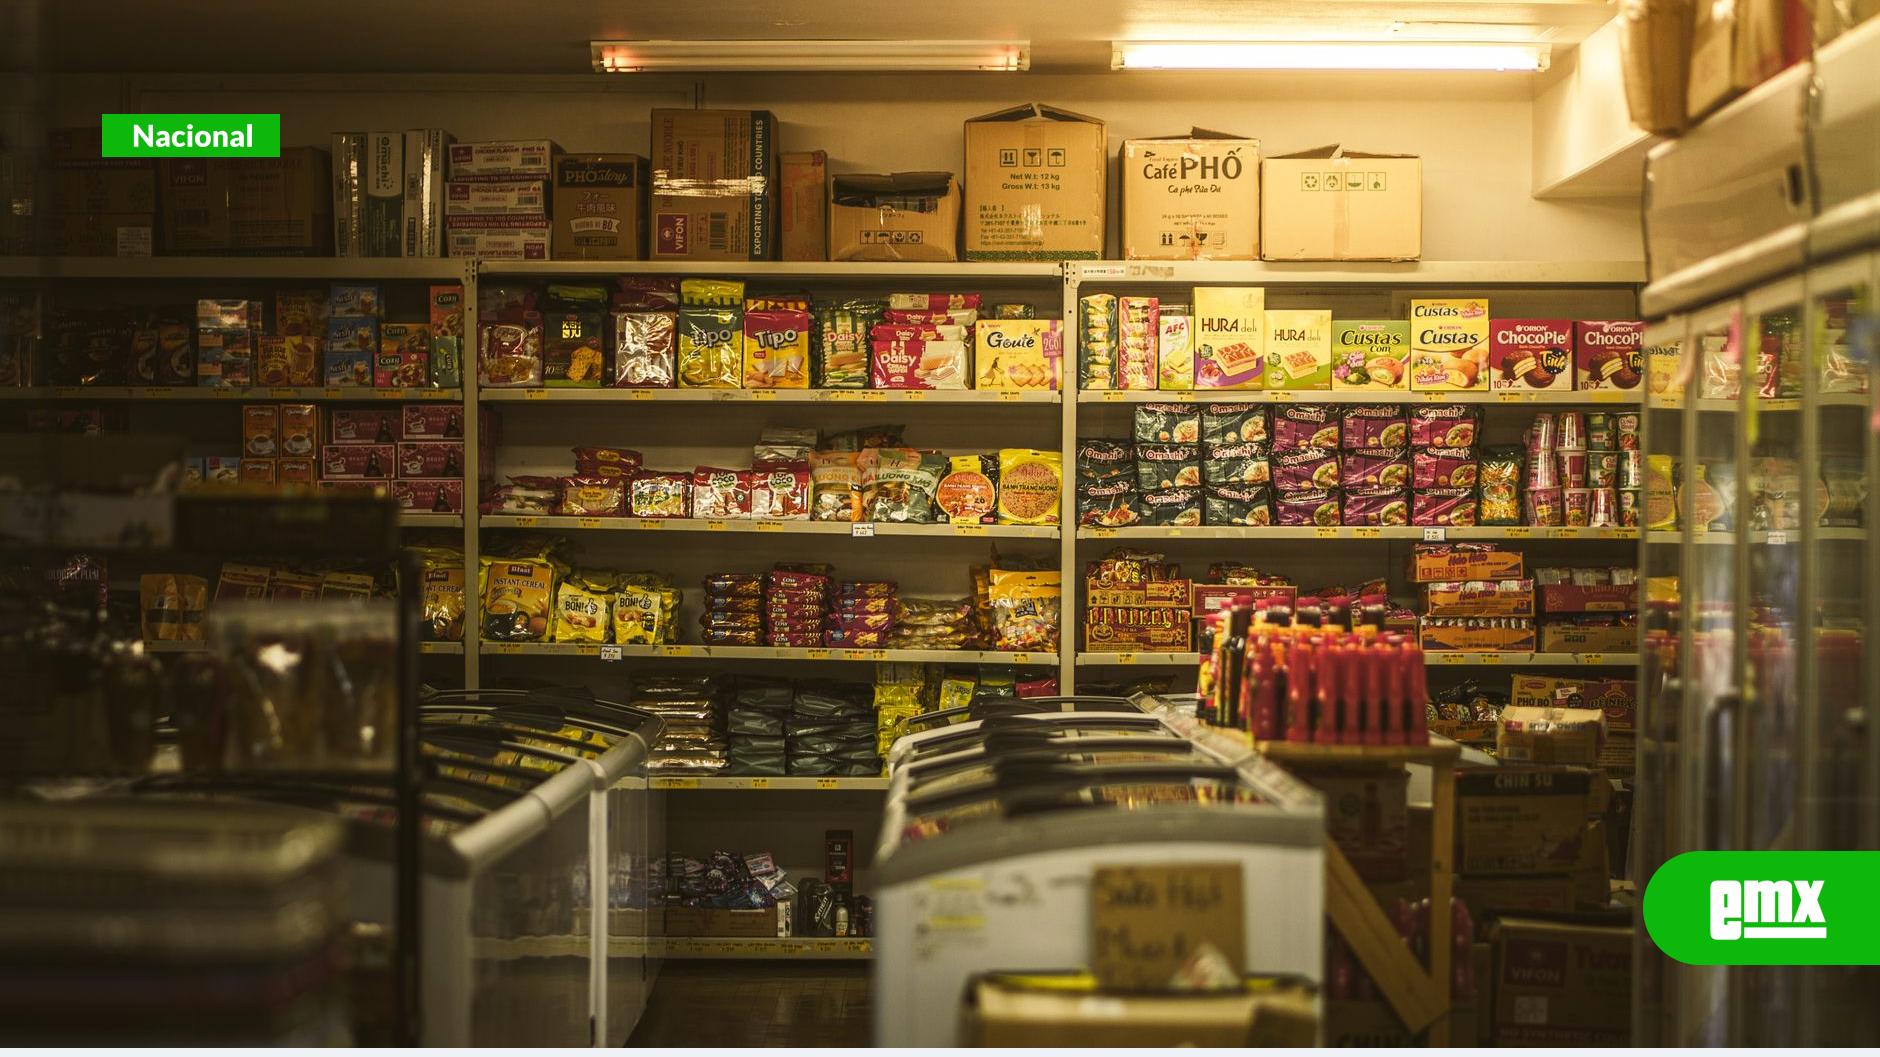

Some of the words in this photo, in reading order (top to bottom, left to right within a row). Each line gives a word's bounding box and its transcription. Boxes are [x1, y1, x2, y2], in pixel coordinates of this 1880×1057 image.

[754, 119, 763, 170] COUNTRIES
[1143, 163, 1177, 179] Café
[1180, 147, 1242, 180] PHỐ
[1050, 173, 1060, 181] kg
[1051, 183, 1060, 191] kg
[675, 217, 684, 250] VIFON
[753, 203, 762, 255] EXPORTING
[1414, 305, 1459, 318] Custas
[1165, 322, 1185, 335] AFC
[1201, 318, 1239, 333] HURA
[1240, 318, 1257, 333] deli
[754, 328, 797, 349] Tipo
[826, 332, 864, 344] Daisy
[1273, 329, 1306, 341] HURA
[1307, 330, 1321, 341] deli
[1340, 330, 1402, 346] Custas
[1419, 329, 1479, 345] Custas
[1497, 330, 1566, 345] ChocoPie
[1584, 331, 1643, 346] ChocoPi
[880, 354, 917, 367] Daisy
[1286, 408, 1327, 422] Omachi
[1356, 407, 1393, 417] Omachi
[1420, 407, 1458, 418] Omachi
[1282, 451, 1320, 465] Omachi
[493, 578, 520, 586] INSTANT
[521, 580, 545, 589] CEREAL
[565, 601, 584, 612] BON!
[619, 597, 639, 608] BON!
[1494, 773, 1530, 788] CHIN
[1534, 773, 1554, 787] SU
[1510, 966, 1562, 983] VIFON
